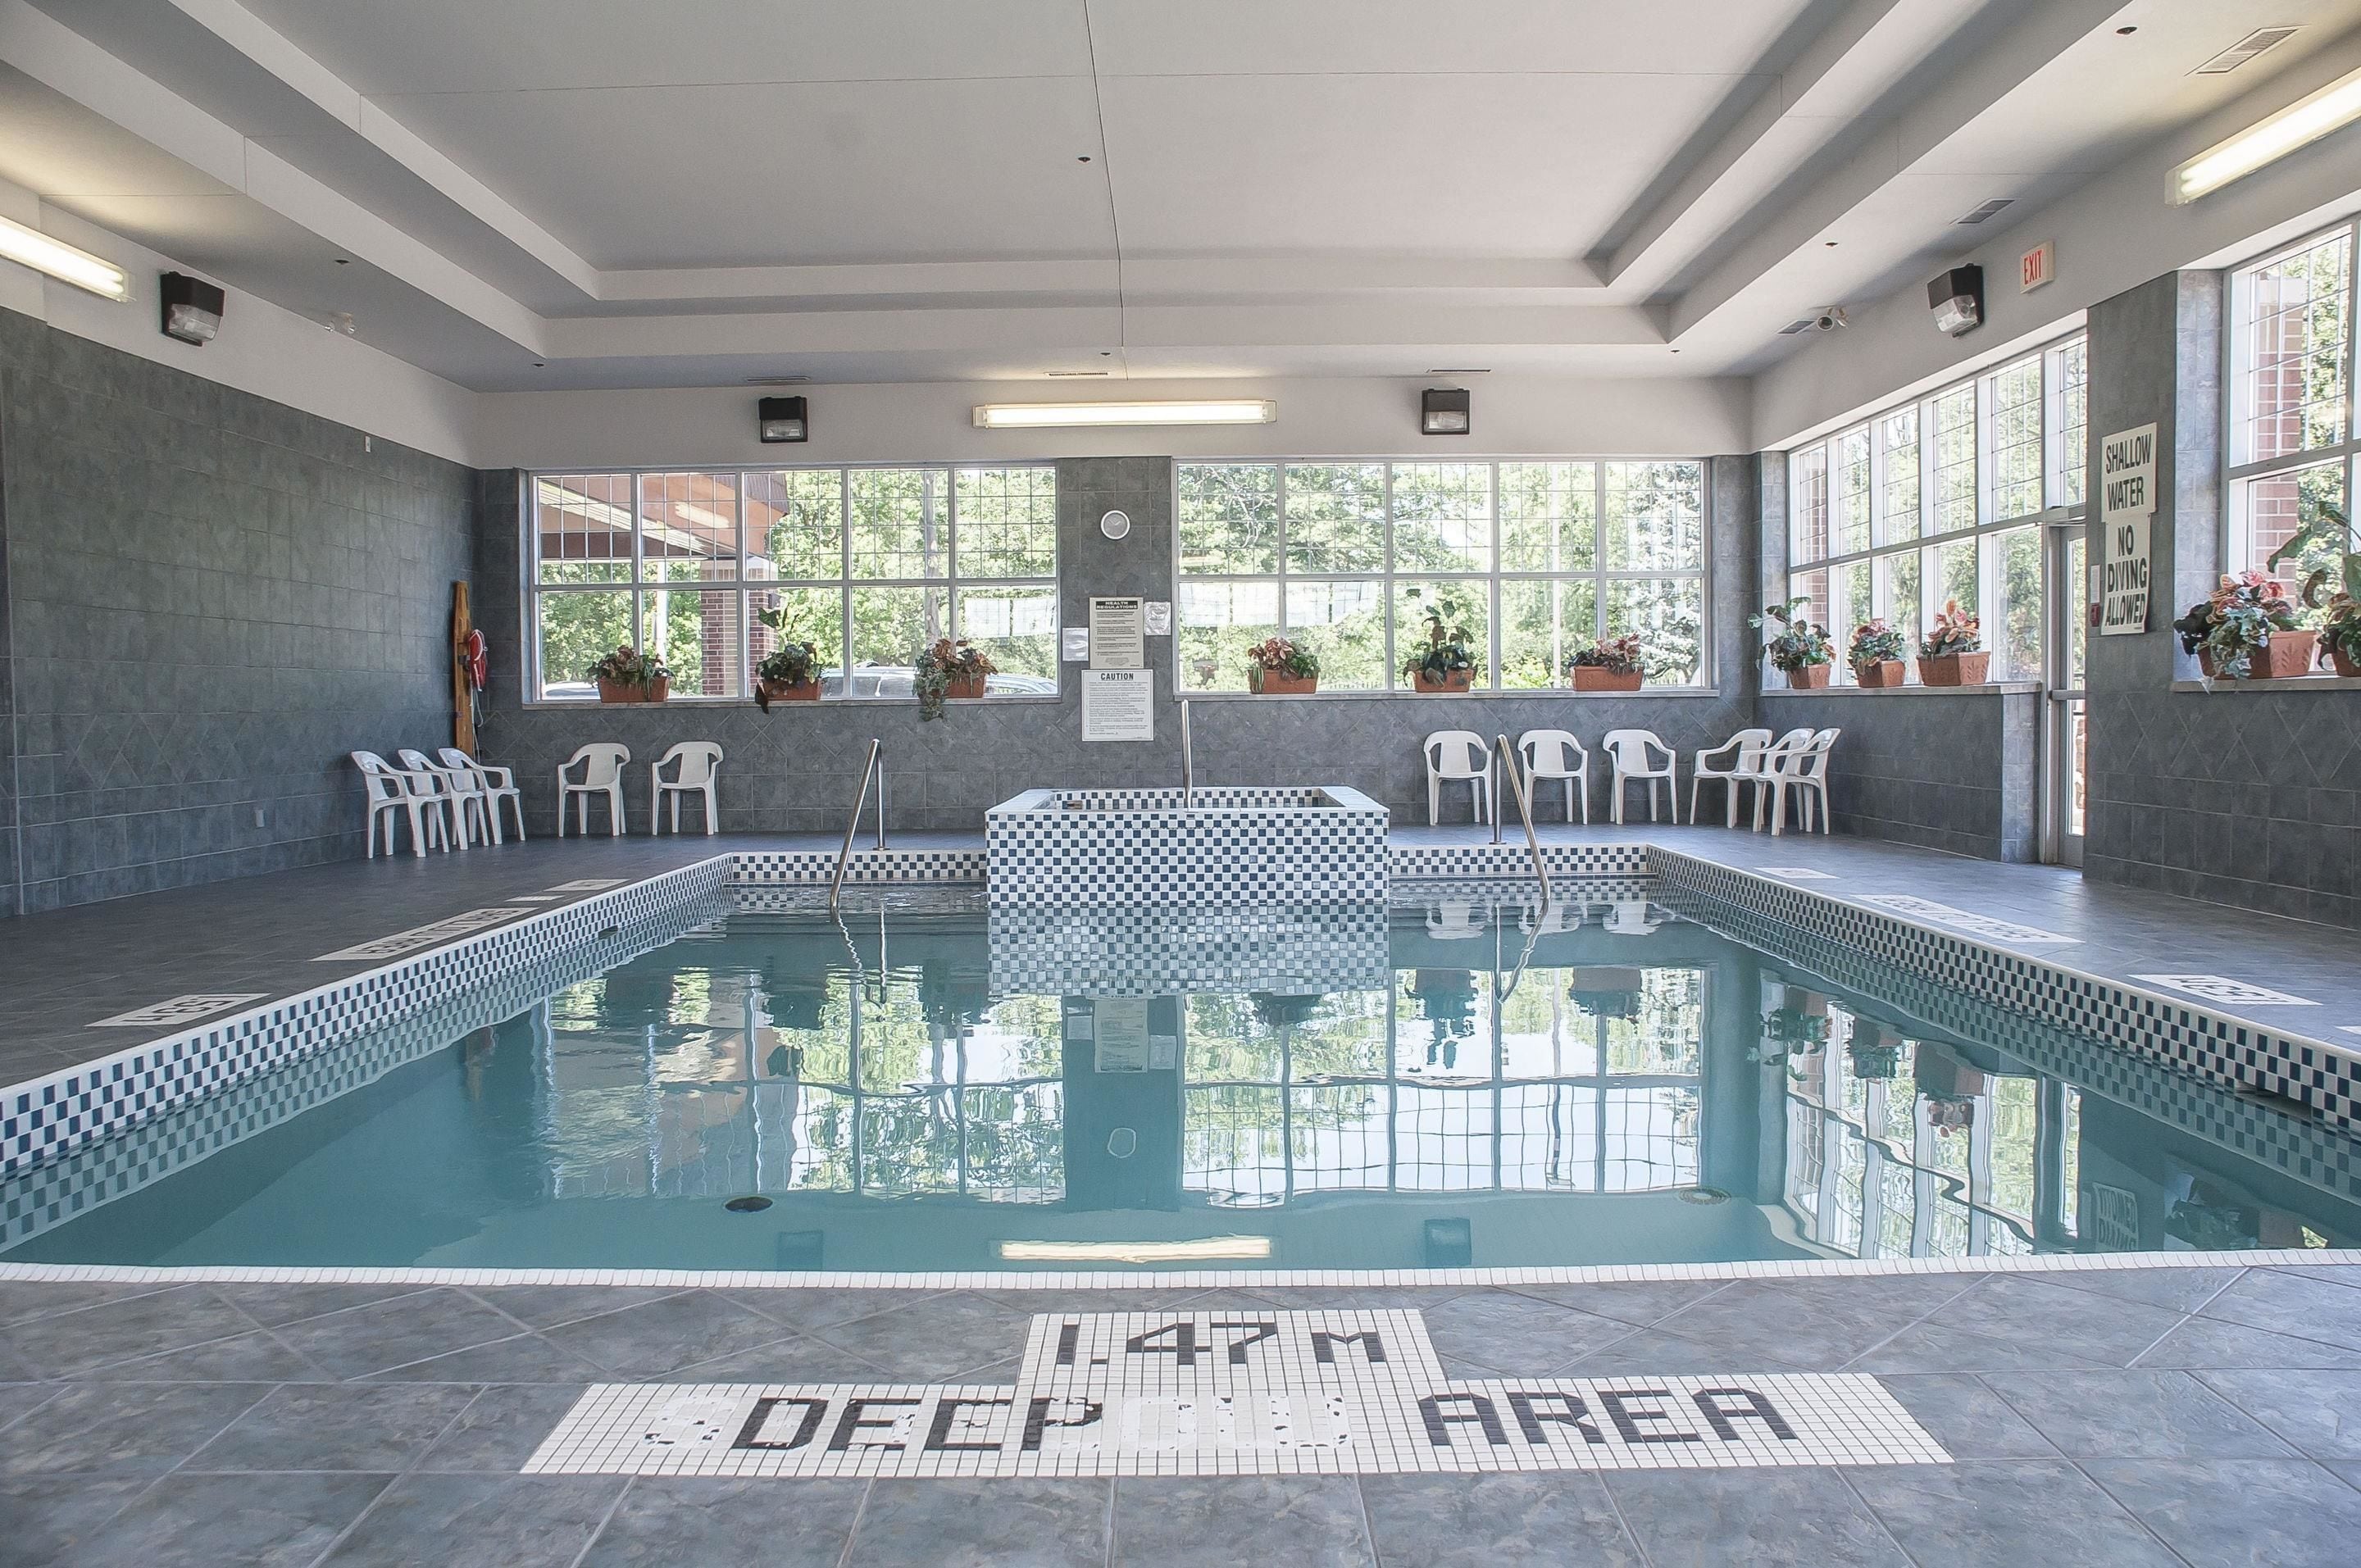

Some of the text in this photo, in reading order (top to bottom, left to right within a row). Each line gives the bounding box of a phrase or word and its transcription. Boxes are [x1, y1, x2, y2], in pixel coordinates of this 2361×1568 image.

[2023, 249, 2043, 285] EXIT
[2105, 433, 2152, 475] SHALLOW
[2107, 475, 2145, 512] WATER
[2118, 525, 2135, 557] NO
[2107, 557, 2147, 593] DIVING
[2104, 593, 2146, 627] ALLOWED
[1055, 1321, 1386, 1366] 1.47 M
[1417, 1388, 1799, 1447] AREA
